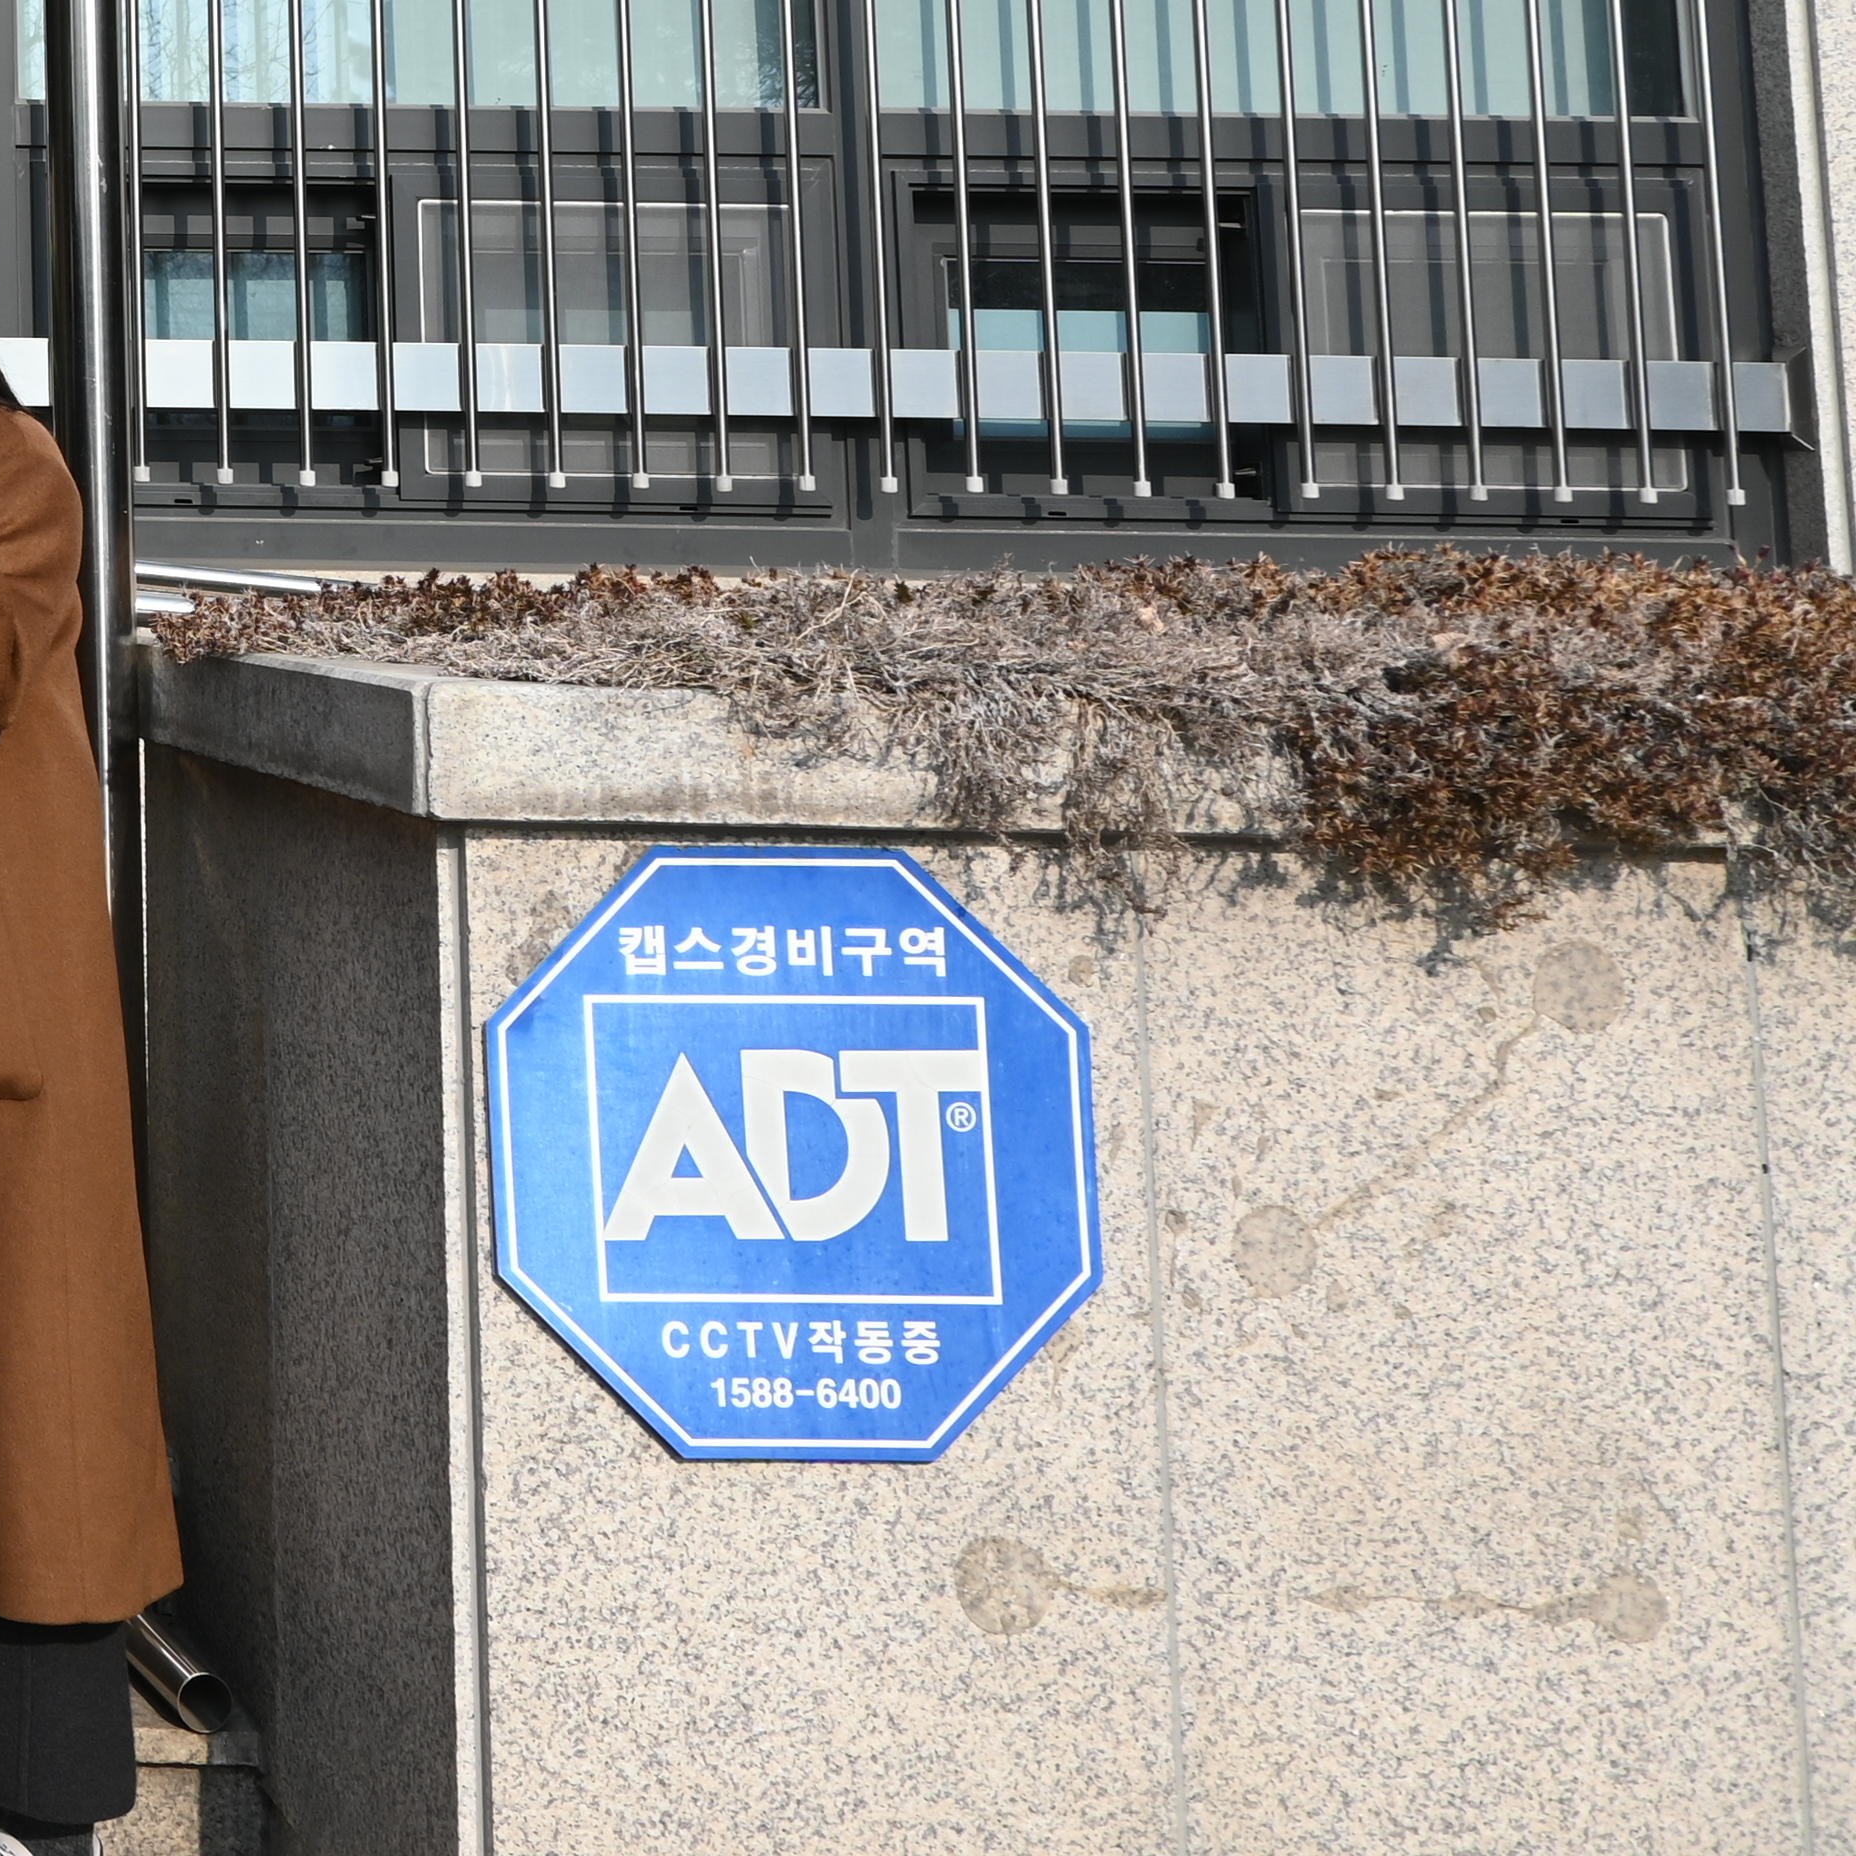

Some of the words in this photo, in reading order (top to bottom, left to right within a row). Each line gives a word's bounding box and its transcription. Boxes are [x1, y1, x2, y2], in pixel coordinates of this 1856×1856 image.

[617, 924, 948, 978] 캡스경비구역
[661, 1319, 941, 1366] CCTV작동중
[709, 1376, 902, 1410] 1588-6400
